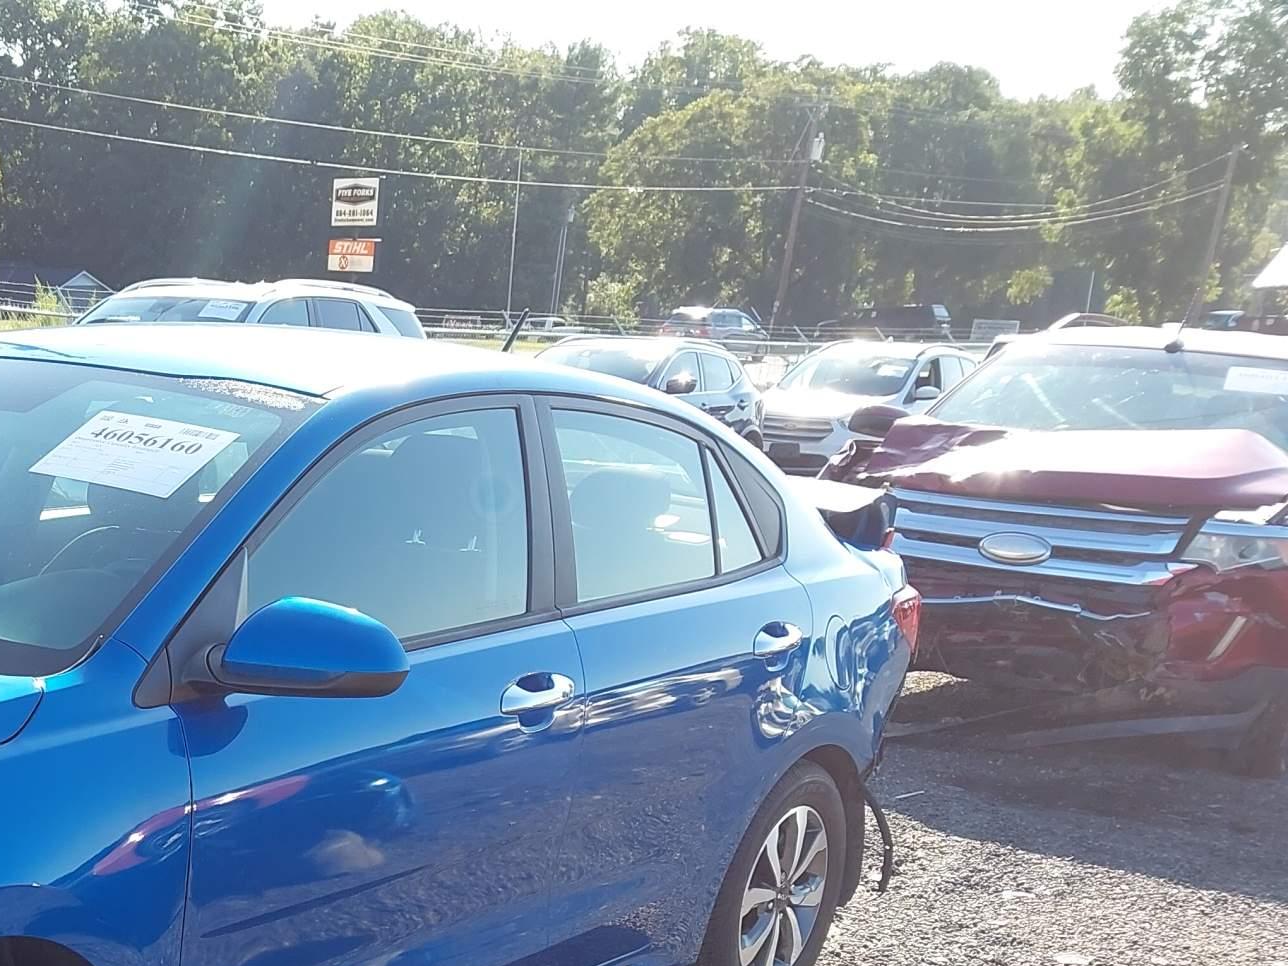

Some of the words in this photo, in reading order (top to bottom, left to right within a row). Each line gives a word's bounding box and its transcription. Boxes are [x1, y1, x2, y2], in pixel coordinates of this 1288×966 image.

[337, 188, 352, 197] FIVE
[353, 188, 374, 197] FORKS
[333, 241, 369, 254] STIHL
[90, 426, 203, 455] 46056160
